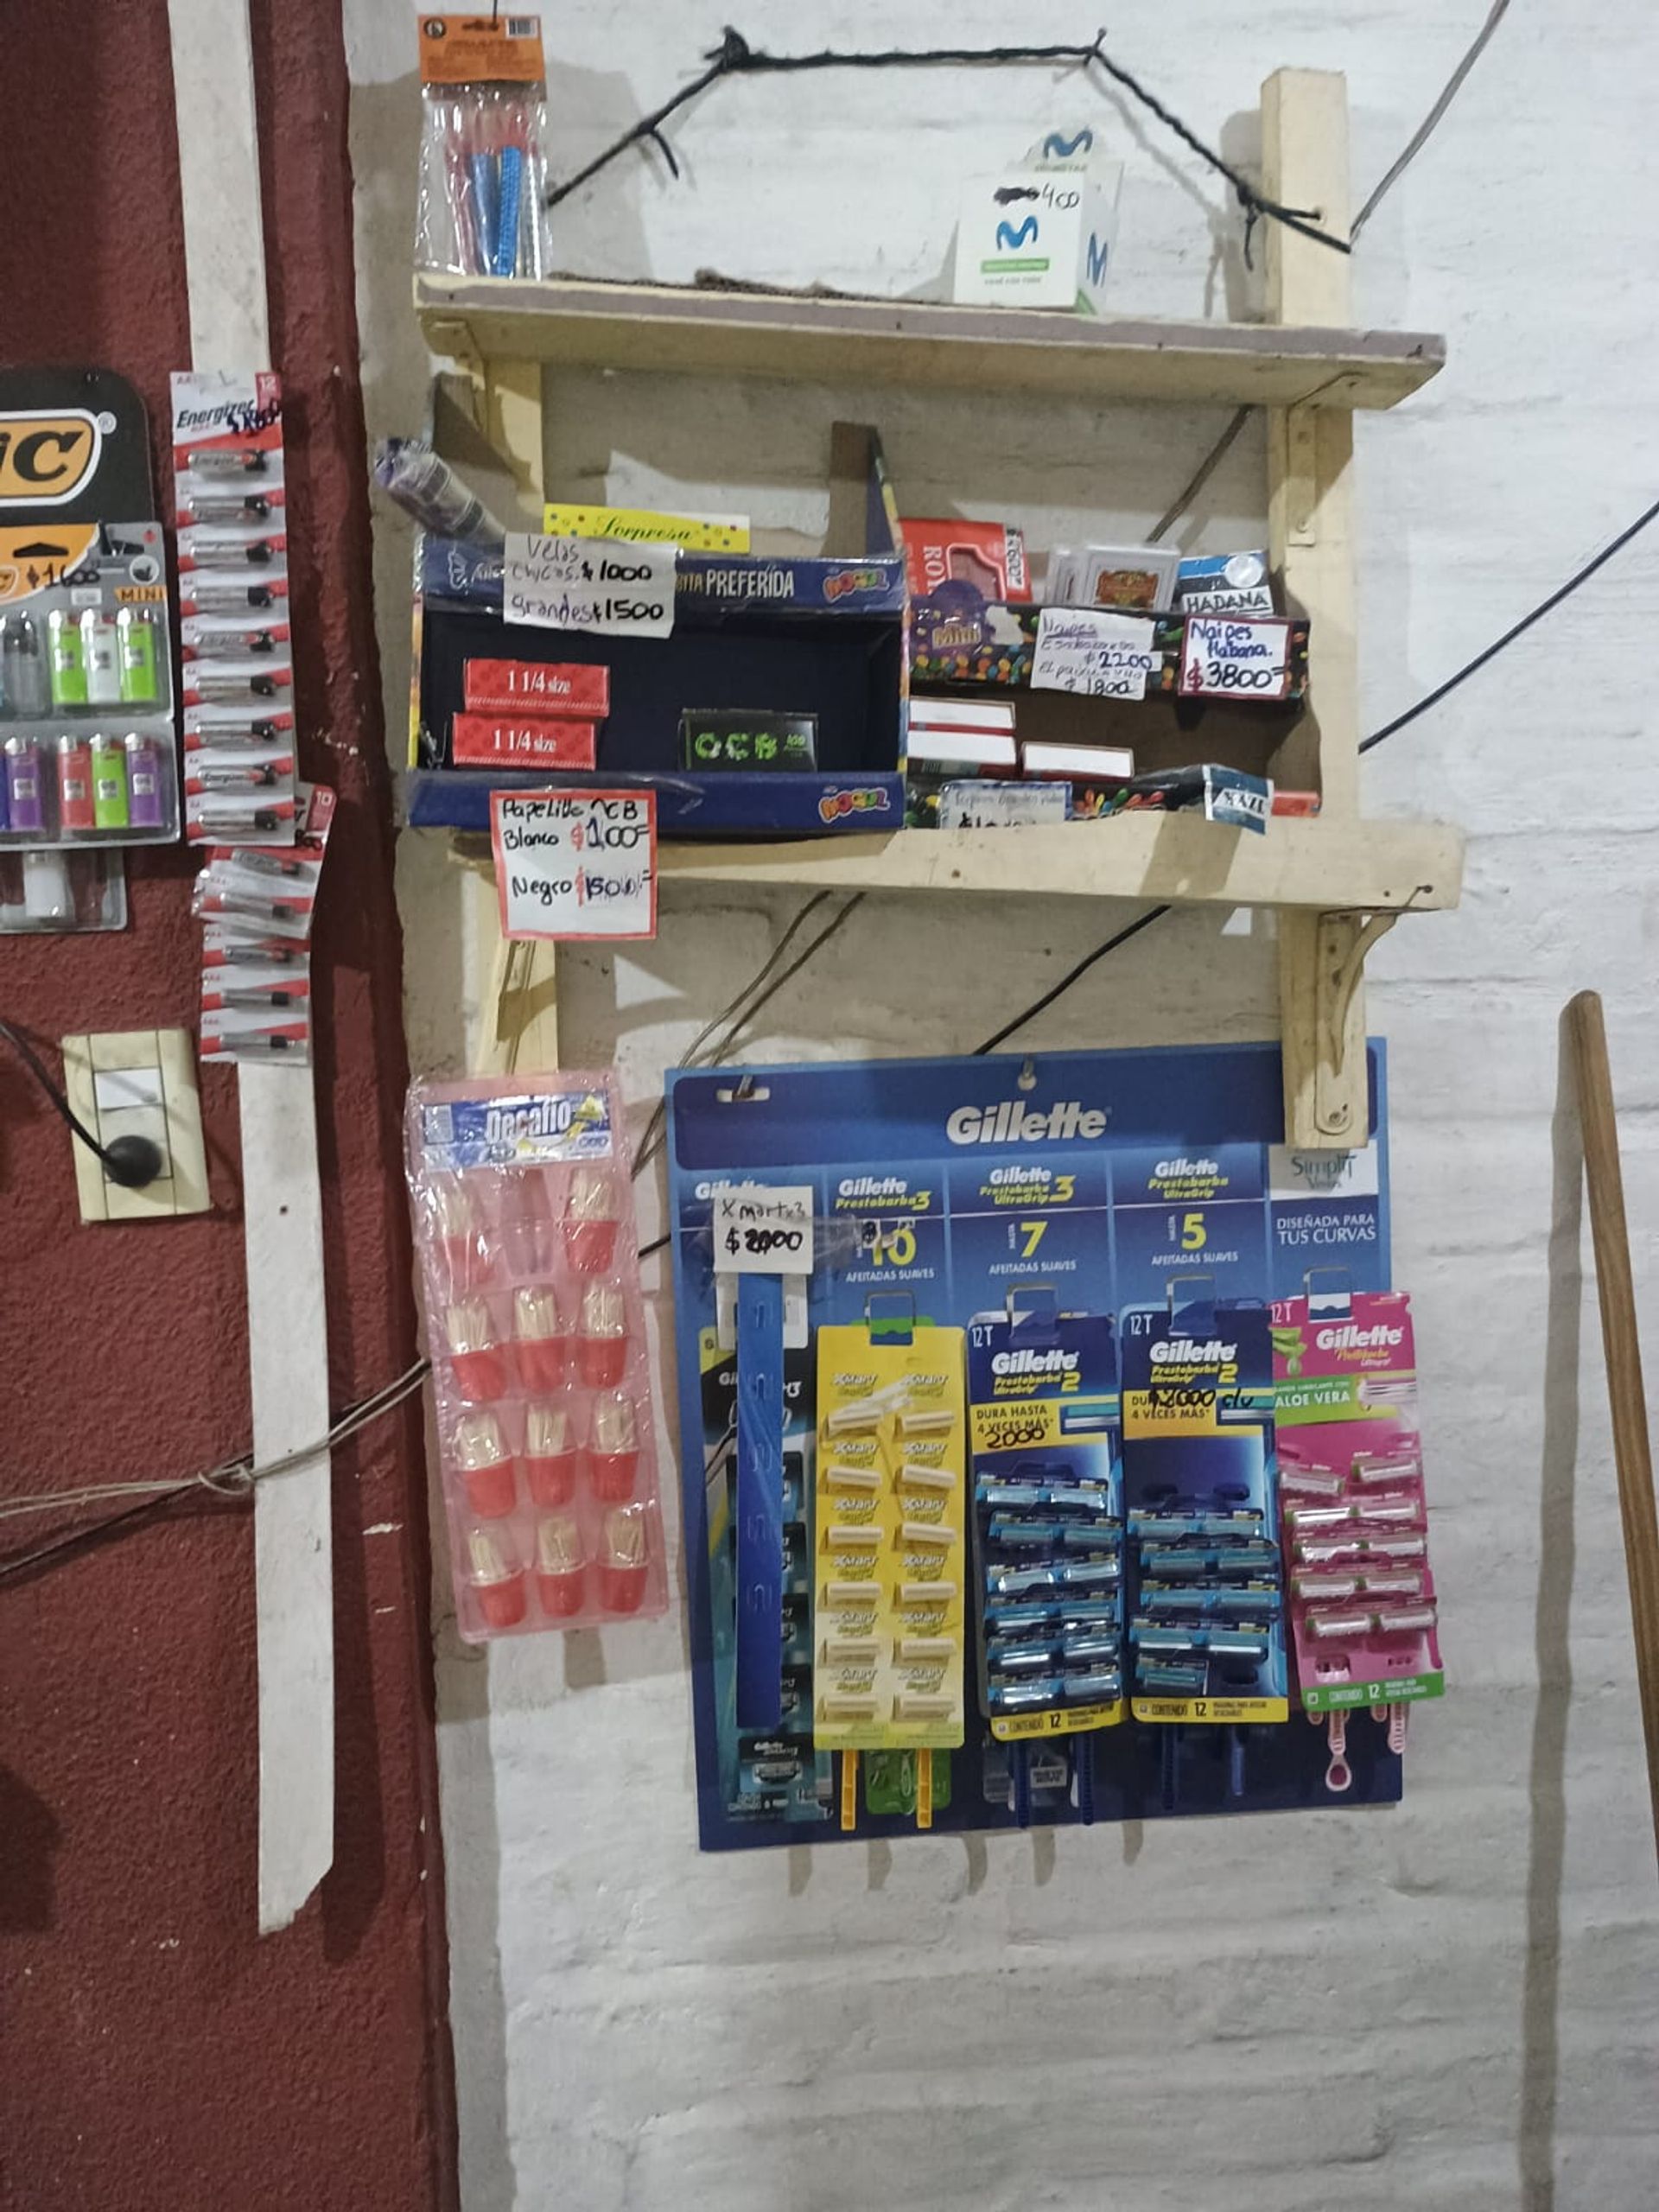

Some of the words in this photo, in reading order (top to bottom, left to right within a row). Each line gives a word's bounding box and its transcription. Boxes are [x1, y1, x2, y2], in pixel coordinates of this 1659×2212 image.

[177, 399, 255, 429] Energizer
[924, 545, 947, 596] ROY
[706, 569, 795, 598] PREFERIDA
[121, 588, 163, 602] MINI
[695, 732, 777, 760] OCB
[316, 791, 334, 807] 10
[504, 826, 560, 851] Blanco
[512, 874, 573, 906] Negro
[946, 1100, 1108, 1145] Gillette
[989, 1166, 1052, 1185] Gillette
[1154, 1158, 1218, 1179] Gillette
[838, 1177, 908, 1198] Gillette
[1049, 1175, 1077, 1202] 3
[1181, 1212, 1208, 1250] 5
[1277, 1213, 1340, 1230] DISEÑADA
[1343, 1213, 1376, 1226] PARA
[1020, 1221, 1048, 1258] 7
[1277, 1230, 1309, 1245] TUS
[1313, 1226, 1376, 1244] CURVAS
[1316, 1325, 1404, 1351] Gillette
[991, 1349, 1080, 1375] Gillette
[1150, 1339, 1238, 1363] Gillette
[1061, 1371, 1081, 1393] 2
[1217, 1363, 1239, 1383] 2
[1274, 1391, 1309, 1408] ALOE
[1313, 1389, 1351, 1405] VERA
[976, 1408, 1007, 1420] DURA
[1010, 1405, 1047, 1417] HASTA
[984, 1428, 1045, 1450] 2000
[1368, 1683, 1381, 1700] 12
[1193, 1701, 1207, 1717] 12
[1050, 1712, 1062, 1730] 12
